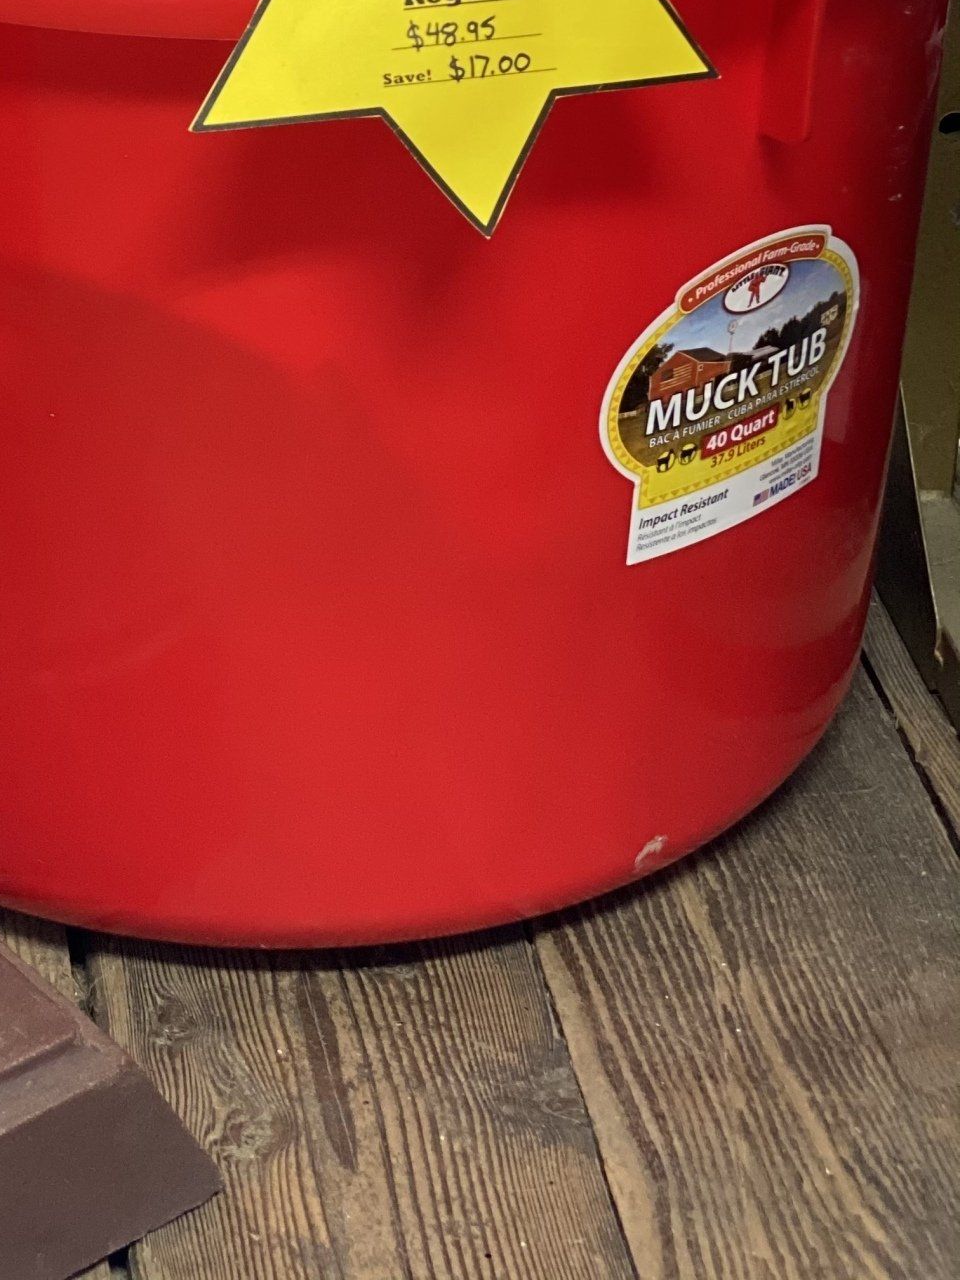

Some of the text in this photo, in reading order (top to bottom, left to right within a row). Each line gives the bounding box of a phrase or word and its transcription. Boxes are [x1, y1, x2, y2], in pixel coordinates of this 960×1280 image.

[406, 15, 496, 52] $48.95
[383, 53, 531, 84] Save! $17.00
[695, 239, 816, 300] Professional Farm-Grade
[645, 328, 827, 436] MUCK TUB
[649, 433, 671, 448] BAC
[682, 415, 721, 437] FUMIER
[727, 402, 753, 420] CUBA
[755, 392, 778, 408] PARA
[707, 409, 775, 451] 40 Quart
[710, 450, 735, 468] 37.9
[737, 436, 766, 456] Liters
[639, 488, 729, 530] Impact Resistant
